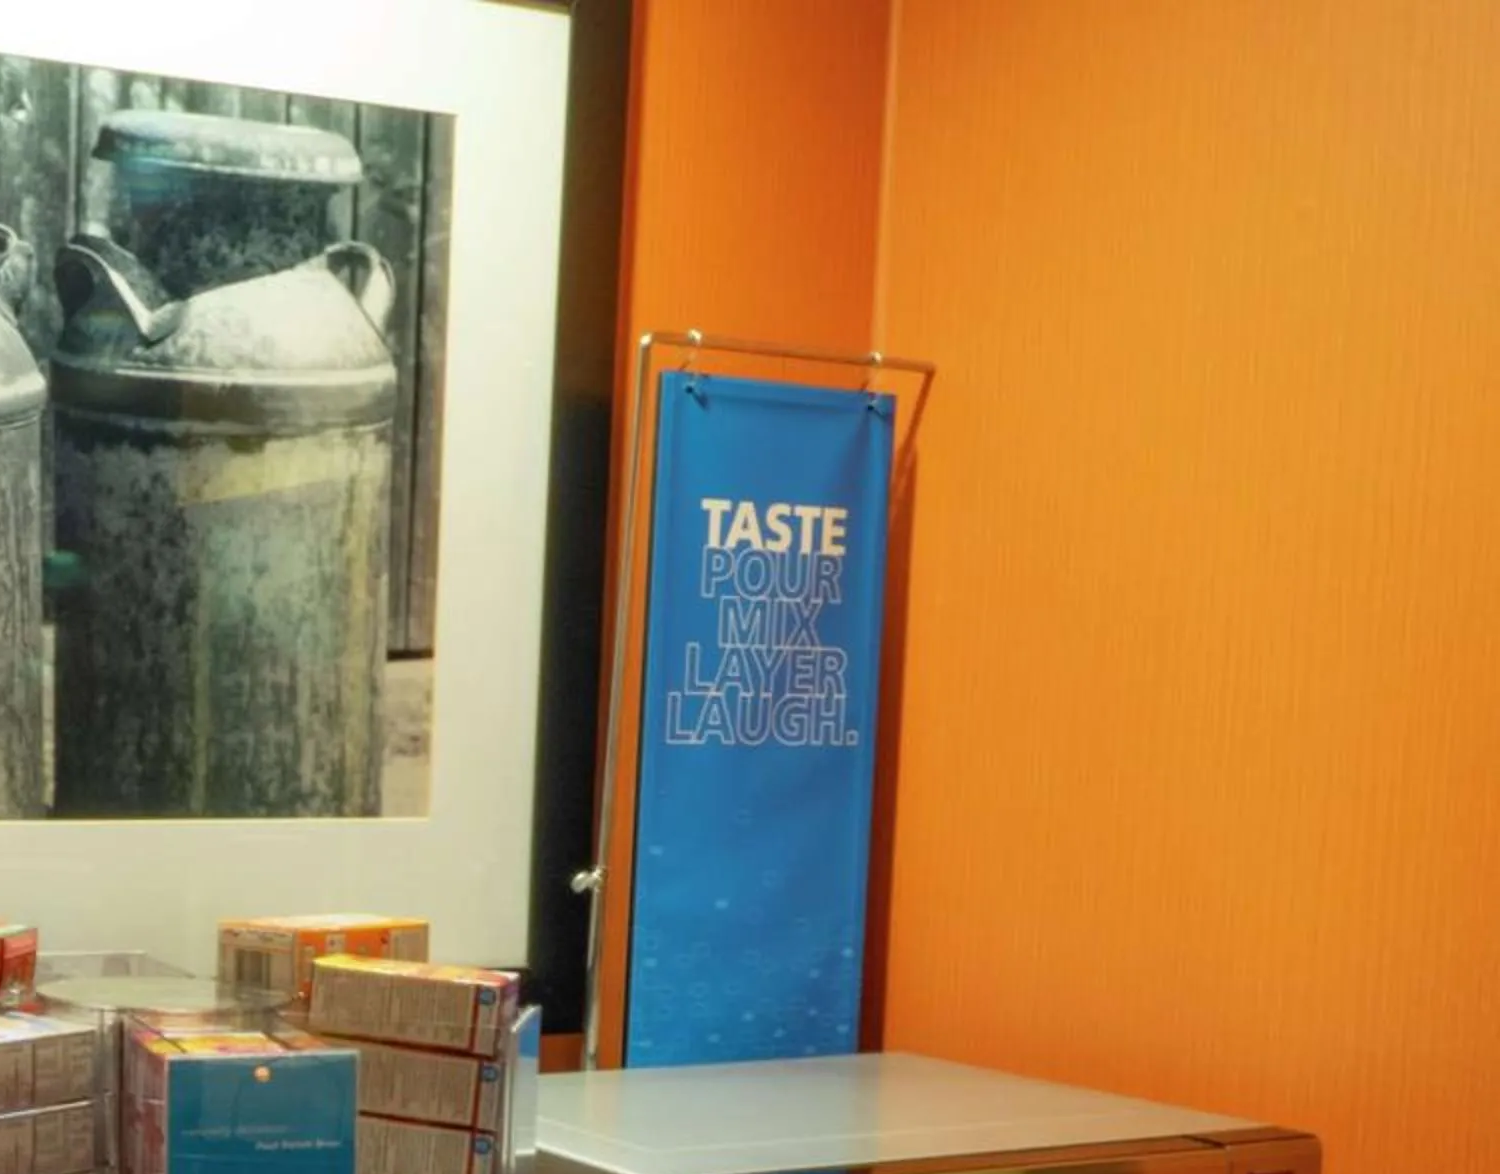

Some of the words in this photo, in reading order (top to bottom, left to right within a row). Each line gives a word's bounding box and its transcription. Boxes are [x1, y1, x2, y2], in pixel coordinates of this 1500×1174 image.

[701, 498, 848, 557] TASTE
[701, 544, 842, 604] POUR
[718, 596, 823, 651] MIX
[684, 642, 848, 698] LAYER
[665, 692, 859, 746] LAUGH.
